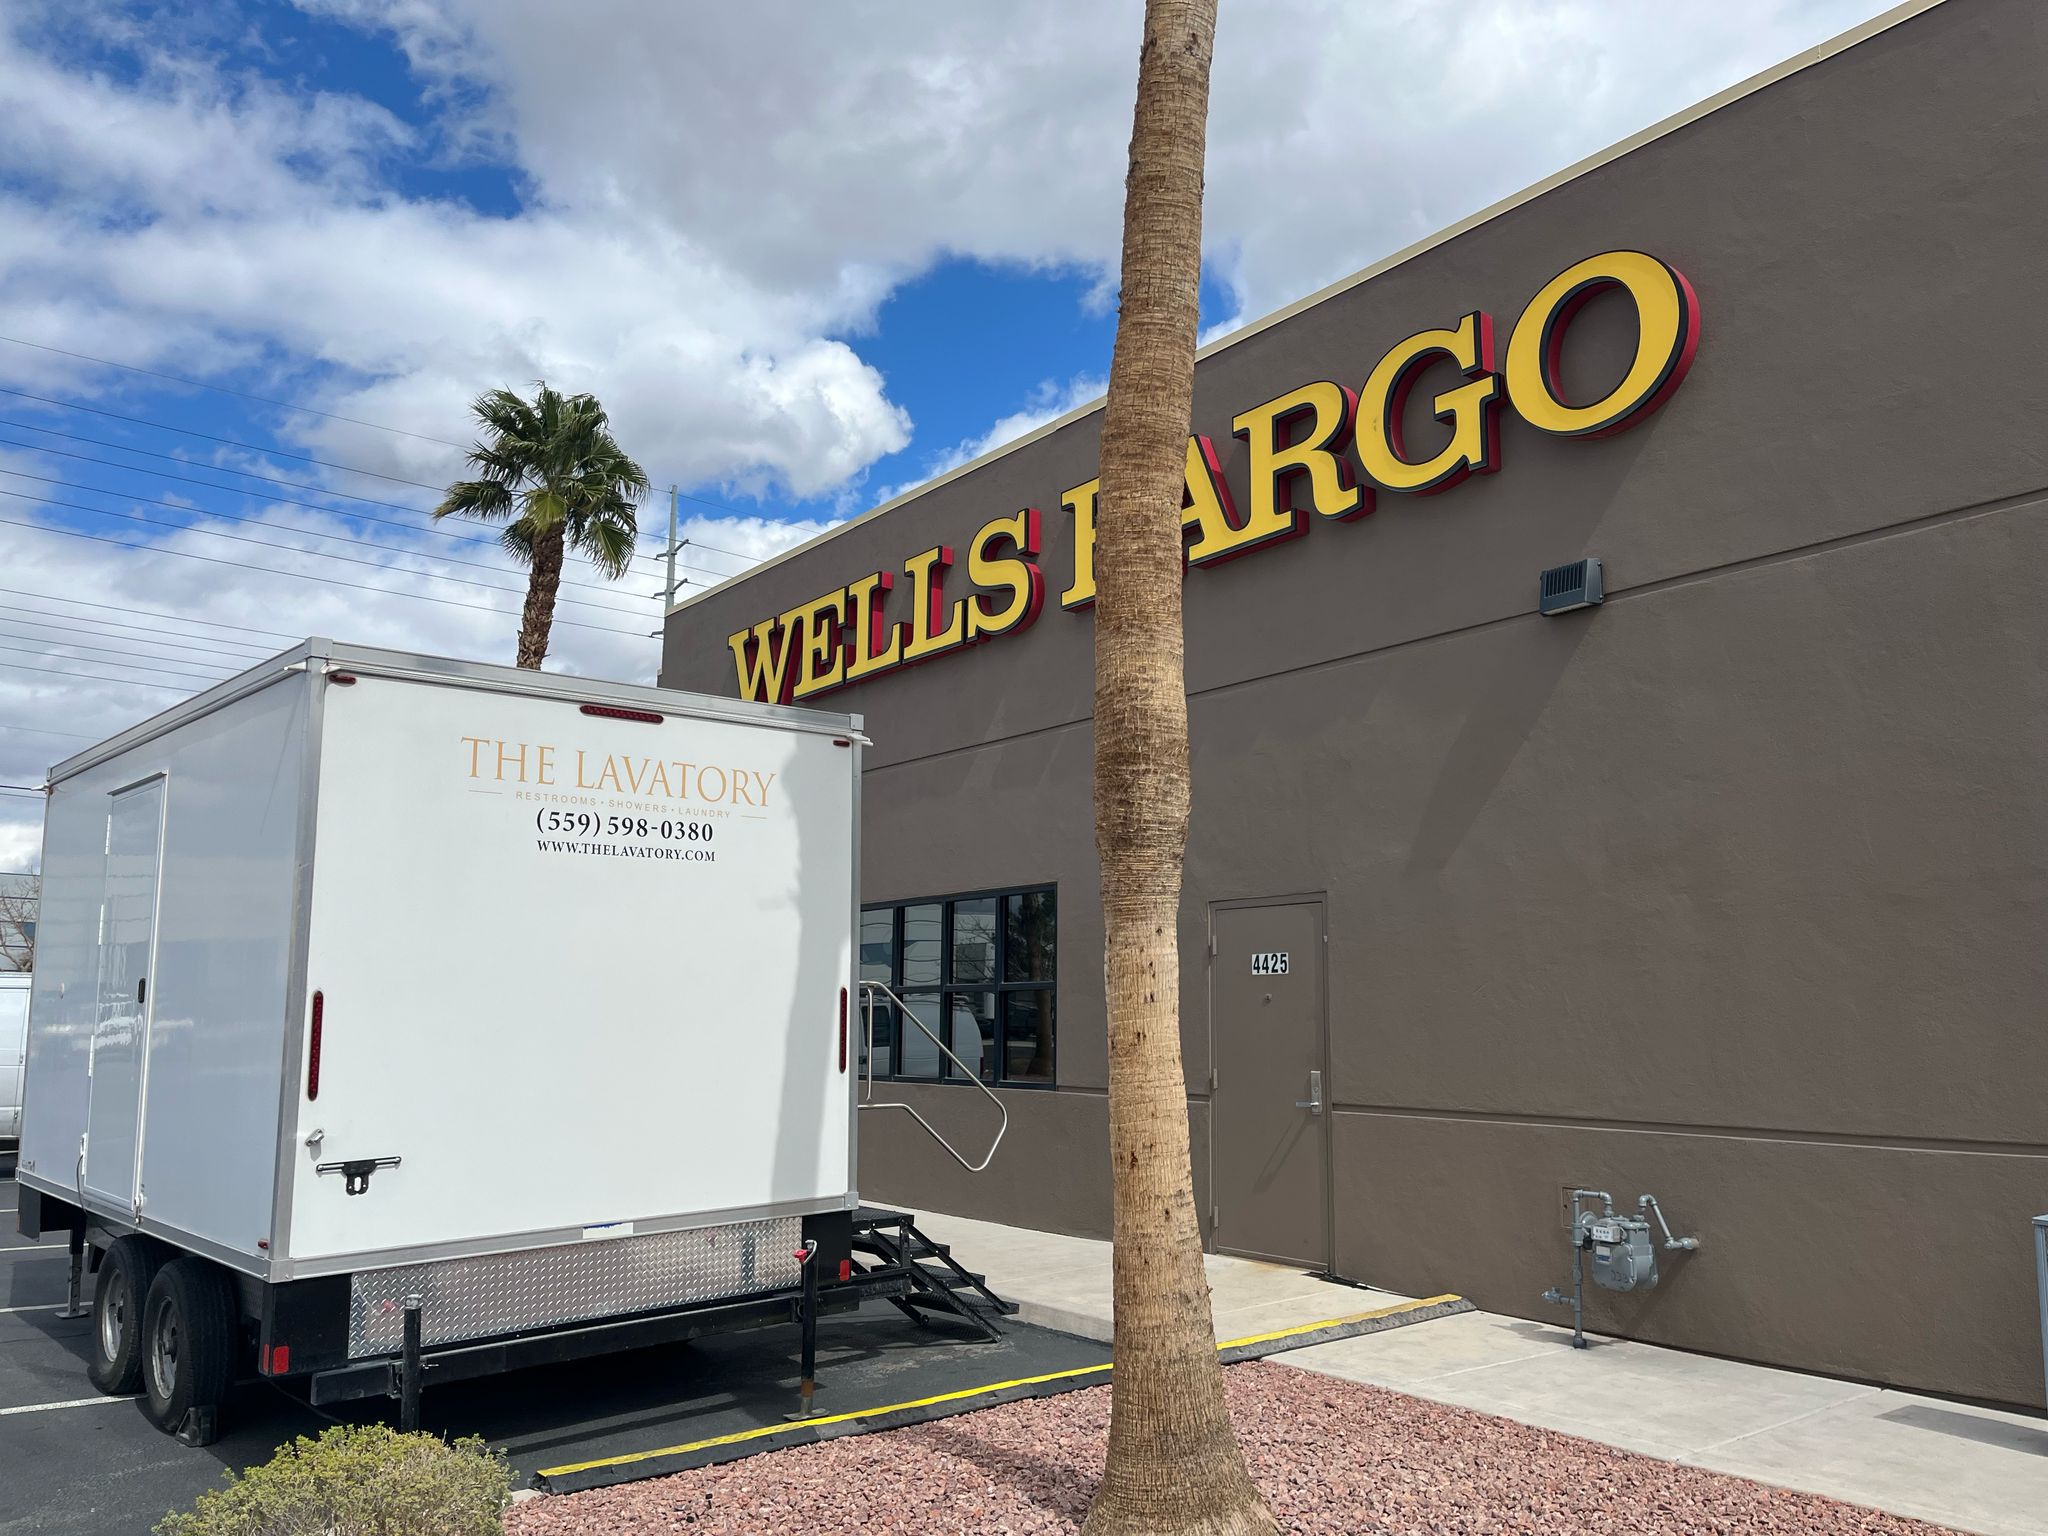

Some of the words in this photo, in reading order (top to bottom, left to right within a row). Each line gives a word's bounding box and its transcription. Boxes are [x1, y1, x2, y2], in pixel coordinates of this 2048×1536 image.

[728, 507, 1045, 704] WELLS
[461, 736, 555, 785] THE
[575, 750, 776, 807] LAVATORY
[516, 790, 597, 807] RESTROOMS
[608, 799, 668, 813] SHOWERS
[678, 806, 731, 819] LAUNDRY
[536, 808, 601, 837] (559)
[606, 816, 714, 843] 598-0380
[536, 839, 716, 862] WWW.THELAVATORY.COM
[1253, 953, 1288, 973] 4425
